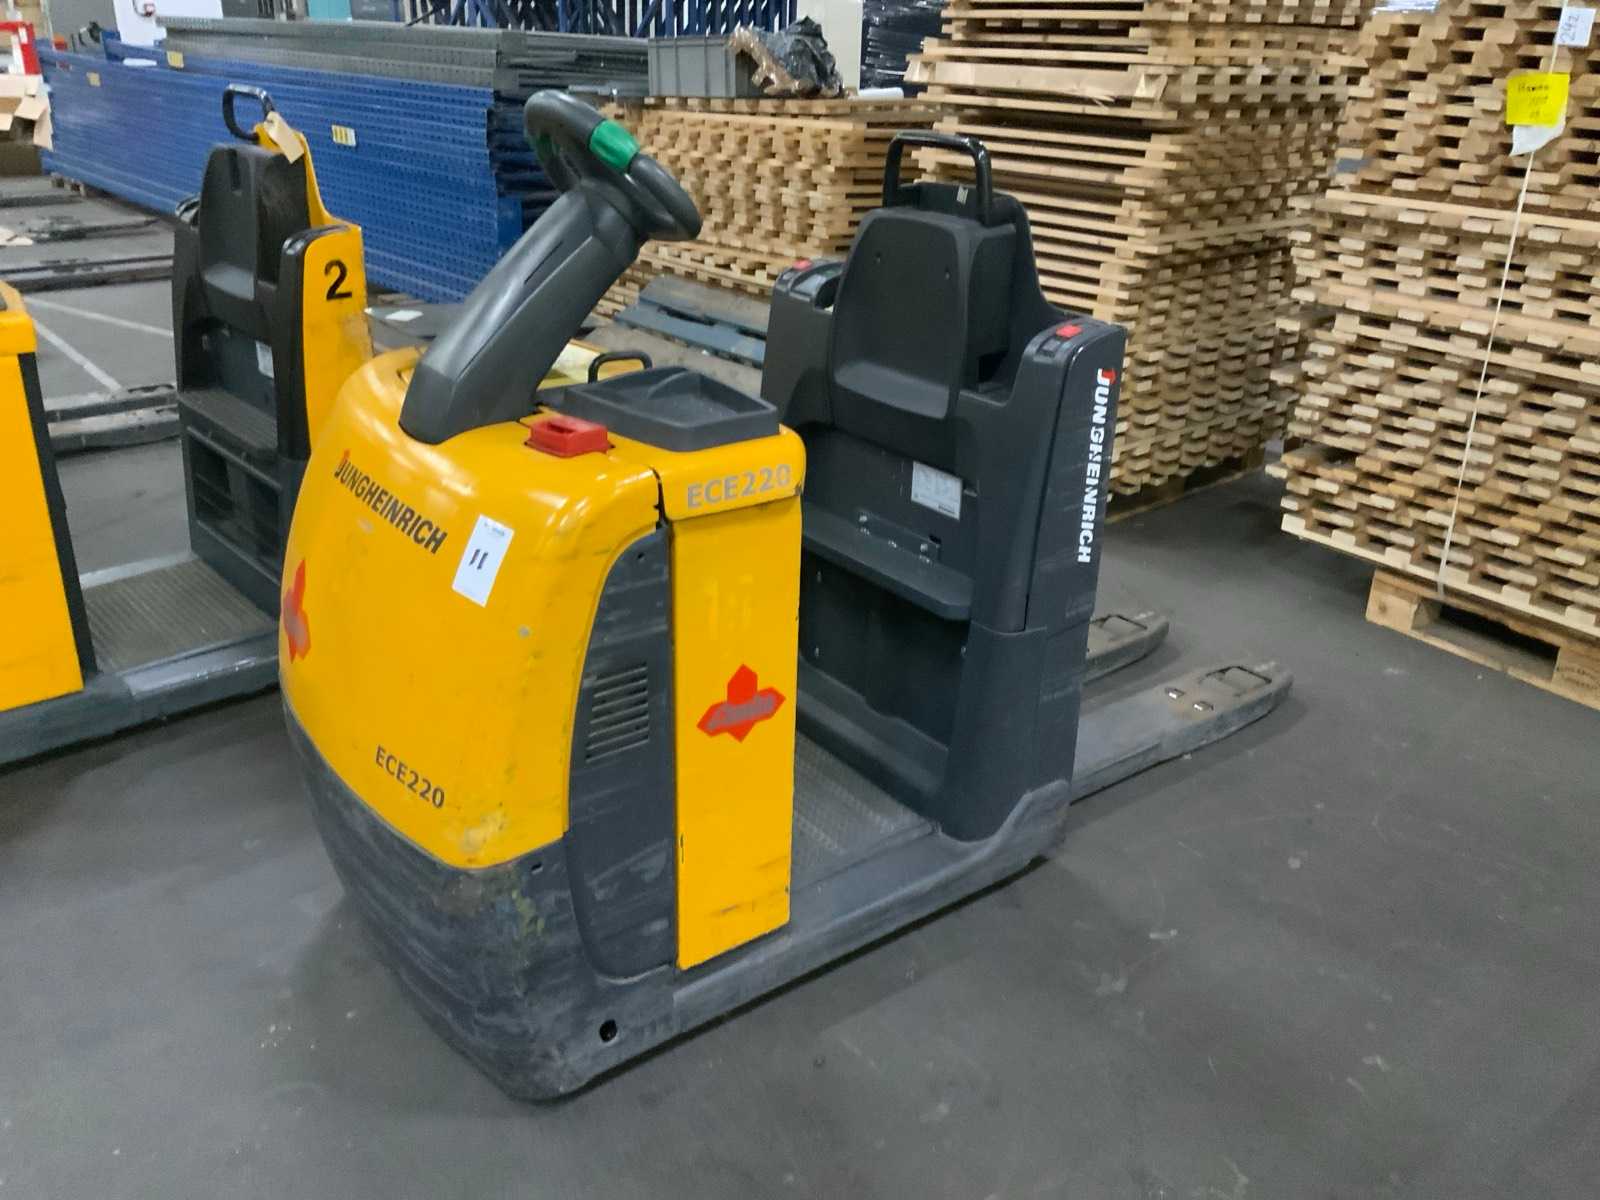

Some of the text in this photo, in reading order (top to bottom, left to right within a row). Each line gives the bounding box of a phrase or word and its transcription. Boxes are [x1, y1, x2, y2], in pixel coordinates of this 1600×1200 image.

[324, 259, 352, 301] 2
[687, 464, 791, 509] ECE220
[1077, 368, 1117, 563] JUNGHEINRICH
[334, 449, 447, 554] JUNGHEINRICH
[375, 745, 445, 808] ECE220
